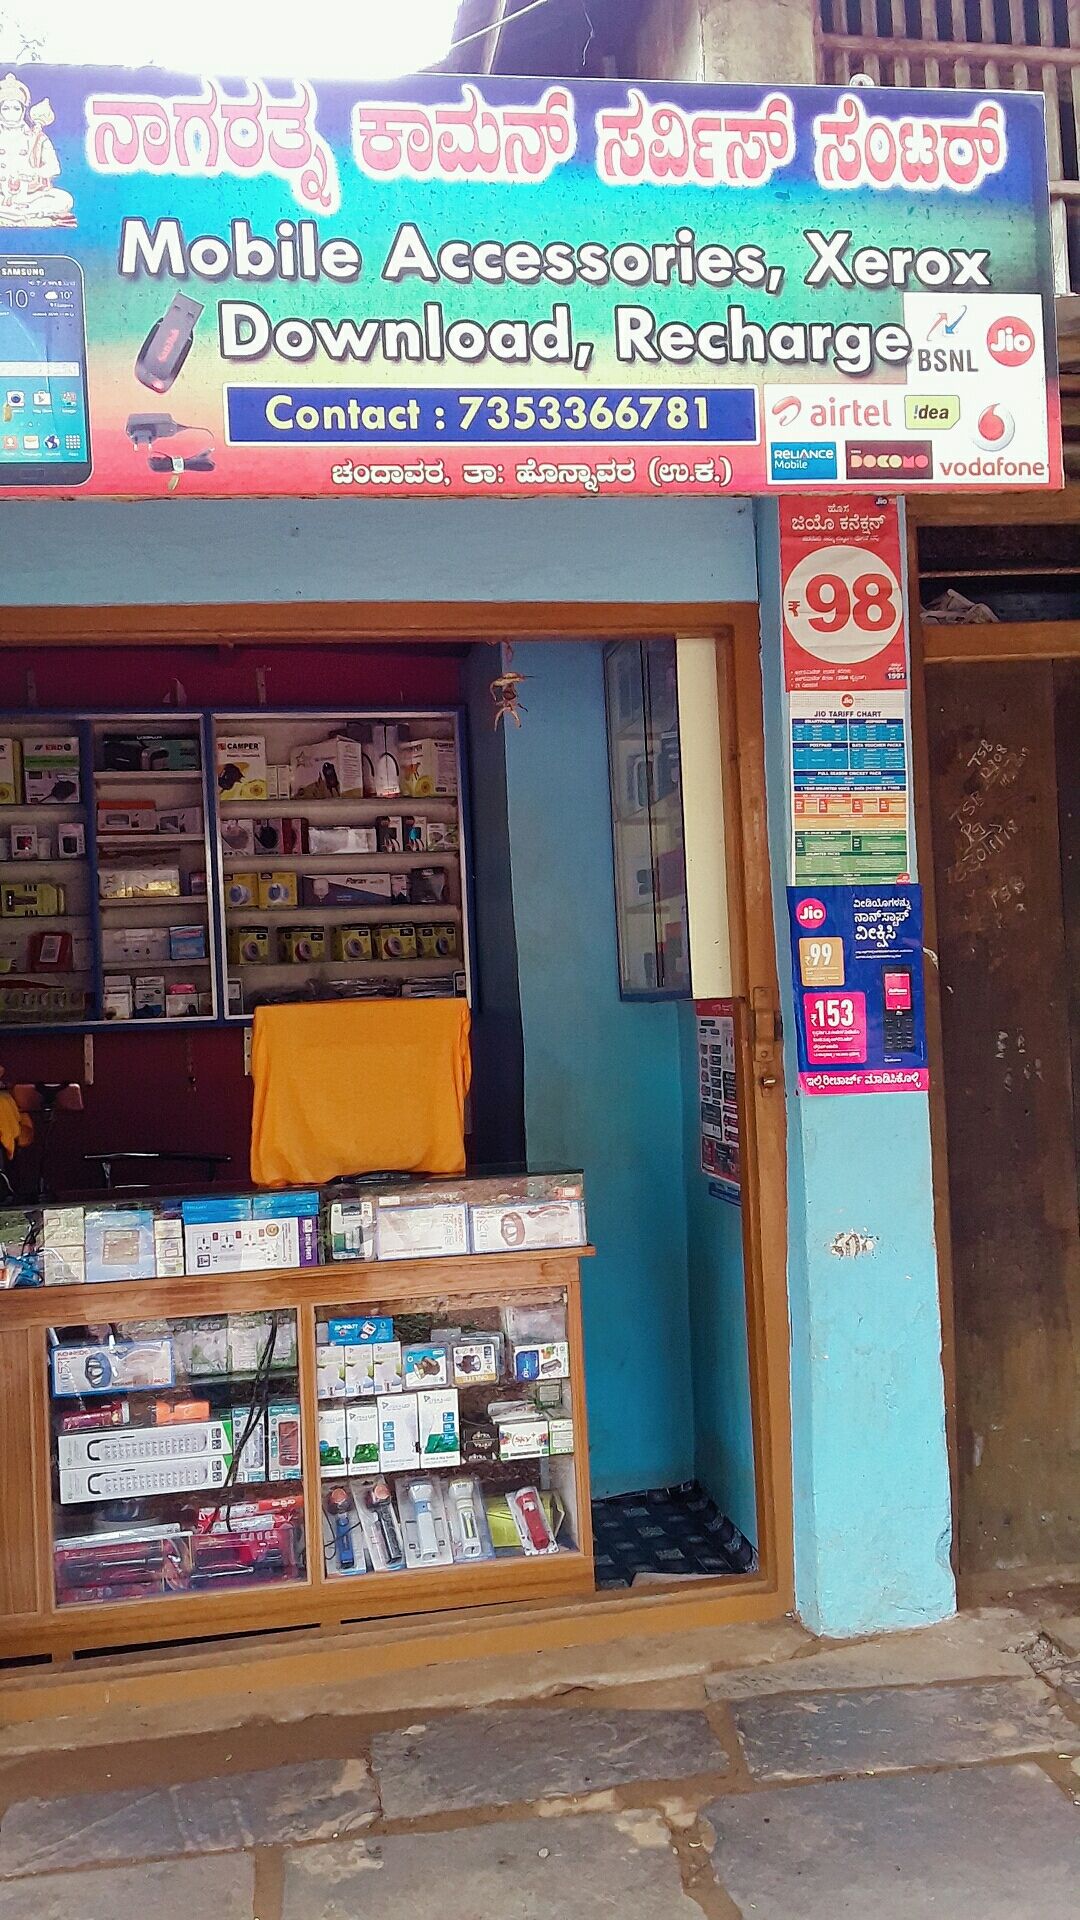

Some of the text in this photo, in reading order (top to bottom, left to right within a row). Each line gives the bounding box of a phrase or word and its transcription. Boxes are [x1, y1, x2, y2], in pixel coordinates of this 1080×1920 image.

[93, 82, 1001, 208] ನಾಗರತ್ನ ಕಾಮನ್ ಸರ್ವಿಸ್ ಸೆಂಟರ್
[120, 217, 992, 294] Mobile Accessories, Xerox
[1, 268, 45, 276] SAMSUNG
[219, 300, 912, 376] Download, Recharge
[990, 327, 1031, 353] Jio
[918, 351, 978, 373] BSNL
[265, 396, 420, 431] Contact
[458, 396, 709, 431] 7353366781
[810, 397, 892, 427] airtel
[331, 458, 452, 488] ಚಂದಾವರ,
[516, 457, 636, 493] ಹೊನ್ನಾವರ
[647, 456, 733, 488] (ಉ.ಕ.)
[774, 459, 808, 470] Mobile
[850, 454, 929, 469] DOCOMO
[939, 457, 1045, 477] vodafone
[800, 905, 823, 920] Jio
